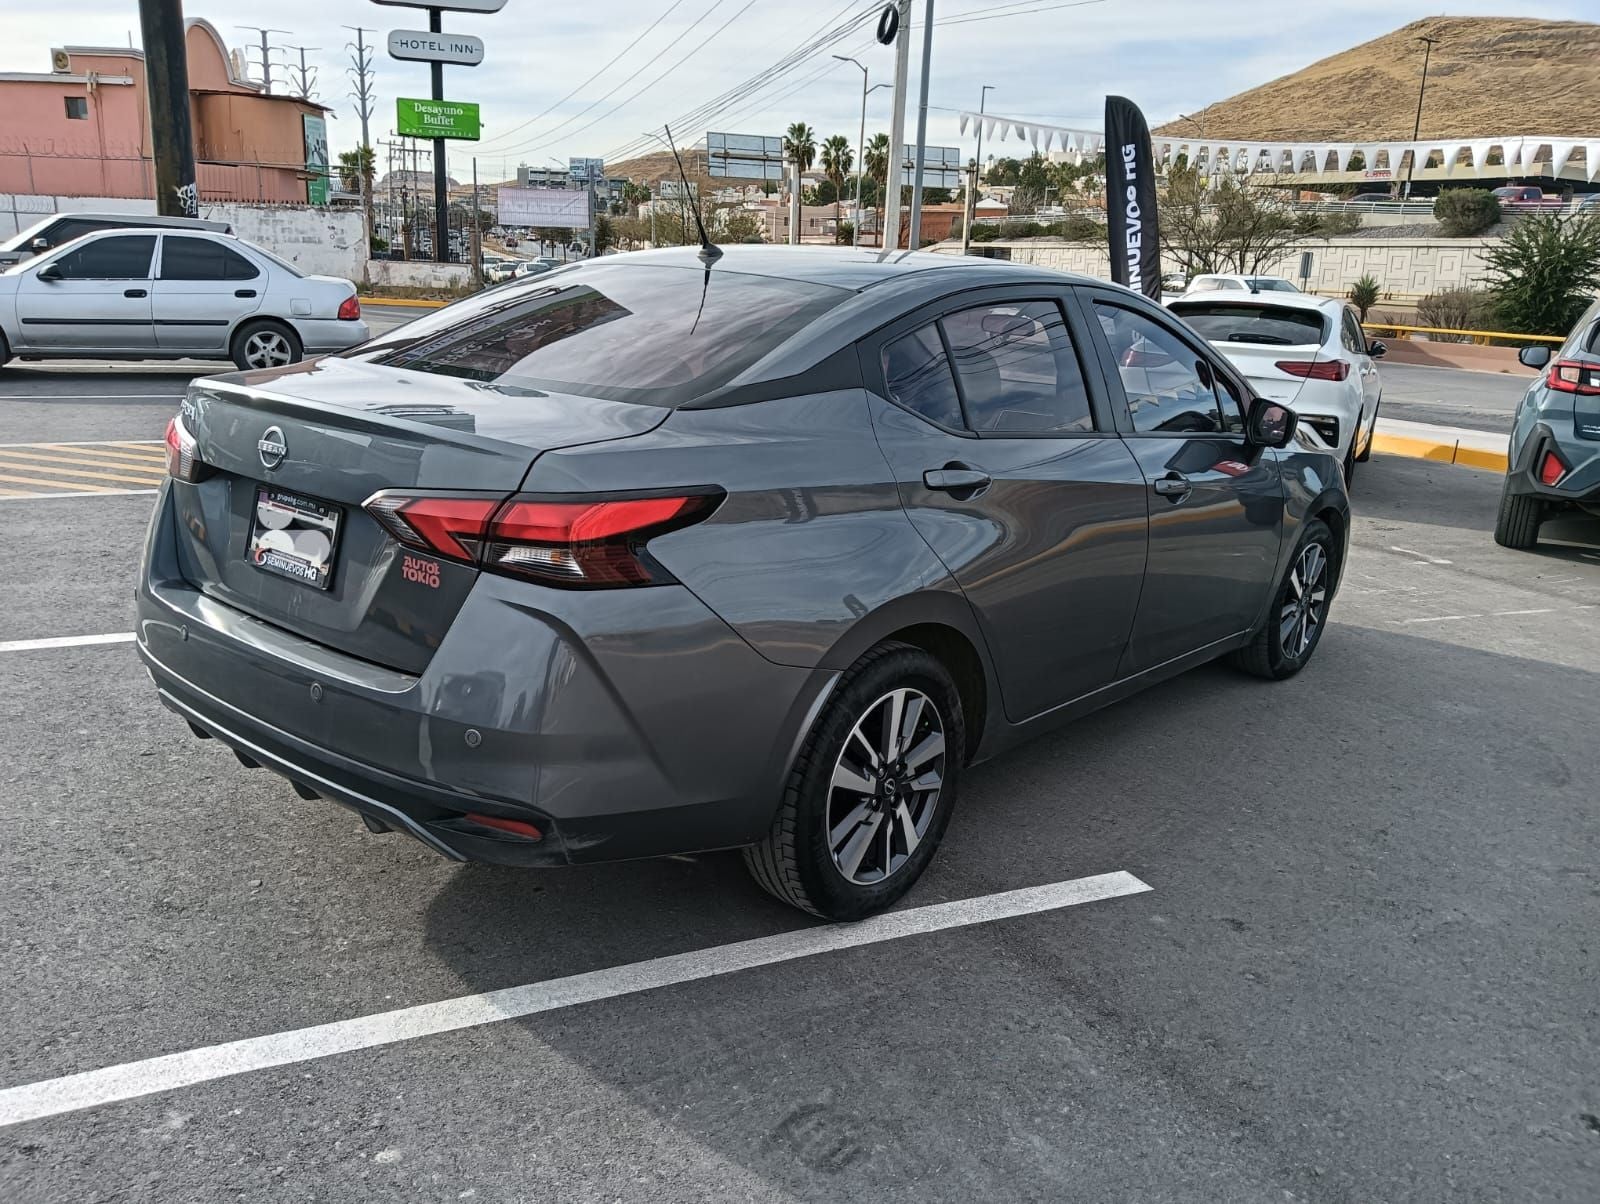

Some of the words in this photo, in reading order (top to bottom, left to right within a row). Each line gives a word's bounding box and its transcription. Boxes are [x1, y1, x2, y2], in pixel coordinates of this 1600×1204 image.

[400, 39, 445, 52] HOTEL
[450, 43, 474, 54] INN
[415, 103, 463, 116] Desayuno
[424, 115, 454, 125] Buffet
[267, 555, 304, 577] SEMINUEVOS
[402, 566, 440, 588] TOKIO
